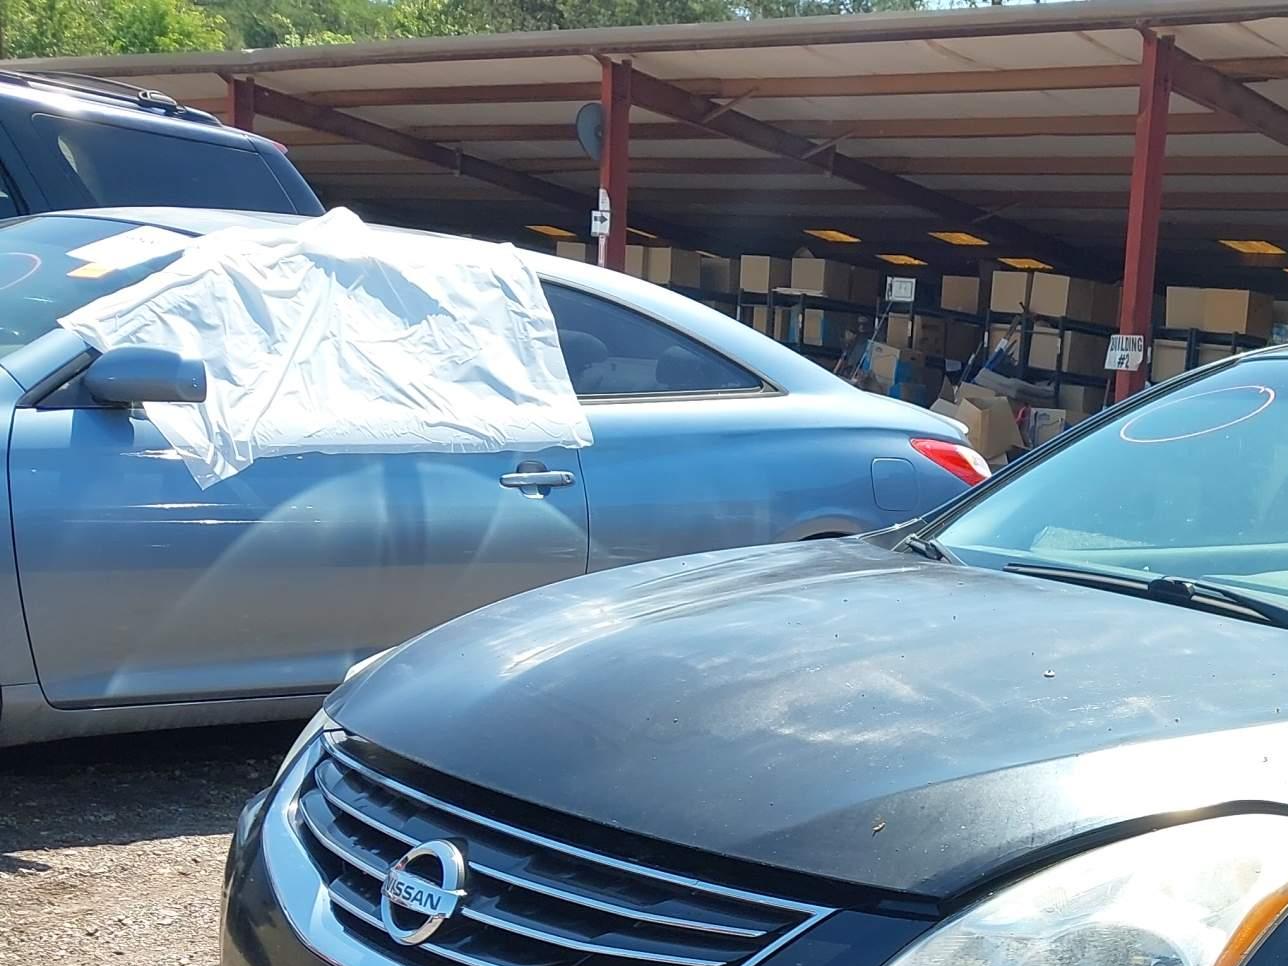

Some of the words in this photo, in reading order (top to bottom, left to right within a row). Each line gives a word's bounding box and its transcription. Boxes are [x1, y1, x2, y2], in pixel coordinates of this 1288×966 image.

[1110, 336, 1143, 352] BUILDING
[1117, 353, 1130, 369] #2
[383, 877, 442, 911] NISSAN
